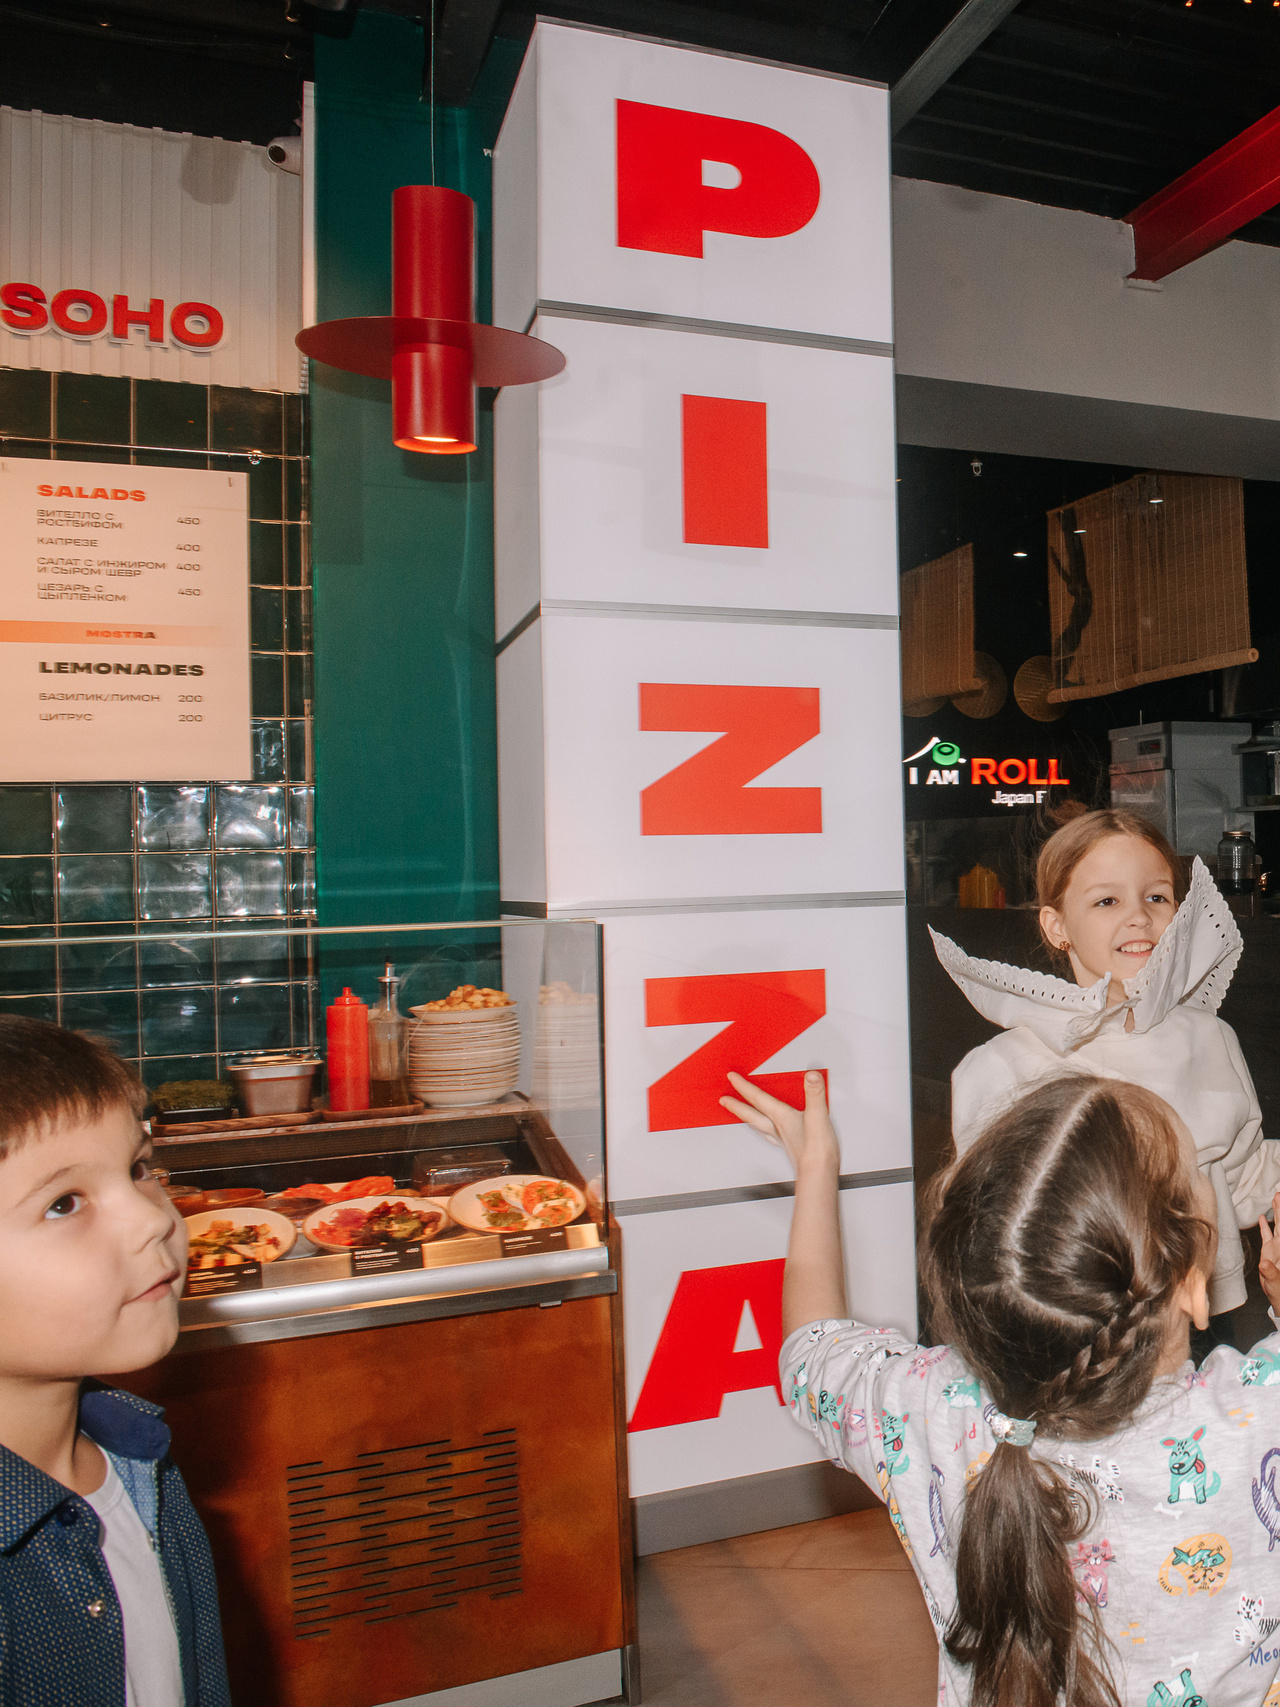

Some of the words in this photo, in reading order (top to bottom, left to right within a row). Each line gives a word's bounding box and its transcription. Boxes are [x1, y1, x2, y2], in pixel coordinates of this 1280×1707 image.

[0, 282, 224, 349] SOHO
[36, 484, 146, 502] SALADS
[37, 509, 101, 520] ВИТЕЛЛО
[105, 512, 114, 521] С
[37, 518, 123, 529] РОСТБИФОМ
[177, 516, 200, 526] 450
[37, 537, 98, 548] КАПРЕЗЕ
[176, 543, 200, 552] 400
[37, 557, 81, 566] САЛАТ
[84, 558, 93, 567] С
[97, 560, 166, 570] ИНЖИРОМ
[176, 563, 200, 572] 400
[37, 566, 47, 574] И
[51, 566, 102, 576] СЫРОМ
[105, 568, 142, 577] ШЕВР
[37, 583, 91, 593] ЦЕЗАРЬ
[94, 584, 103, 593] С
[178, 588, 201, 597] 450
[37, 592, 126, 602] ЦЫПЛЕНКОМ
[85, 629, 157, 640] MOSTRA
[38, 661, 205, 677] LEMONADES
[39, 692, 161, 703] БАЗИЛИК/ЛИМОН
[178, 694, 203, 703] 200
[39, 712, 94, 722] ЦИТРУС
[178, 713, 203, 723] 200
[615, 98, 829, 1434] PIZZA
[909, 766, 919, 785] I
[925, 769, 960, 786] AM
[970, 757, 1071, 786] ROLL
[991, 790, 1035, 807] Japan
